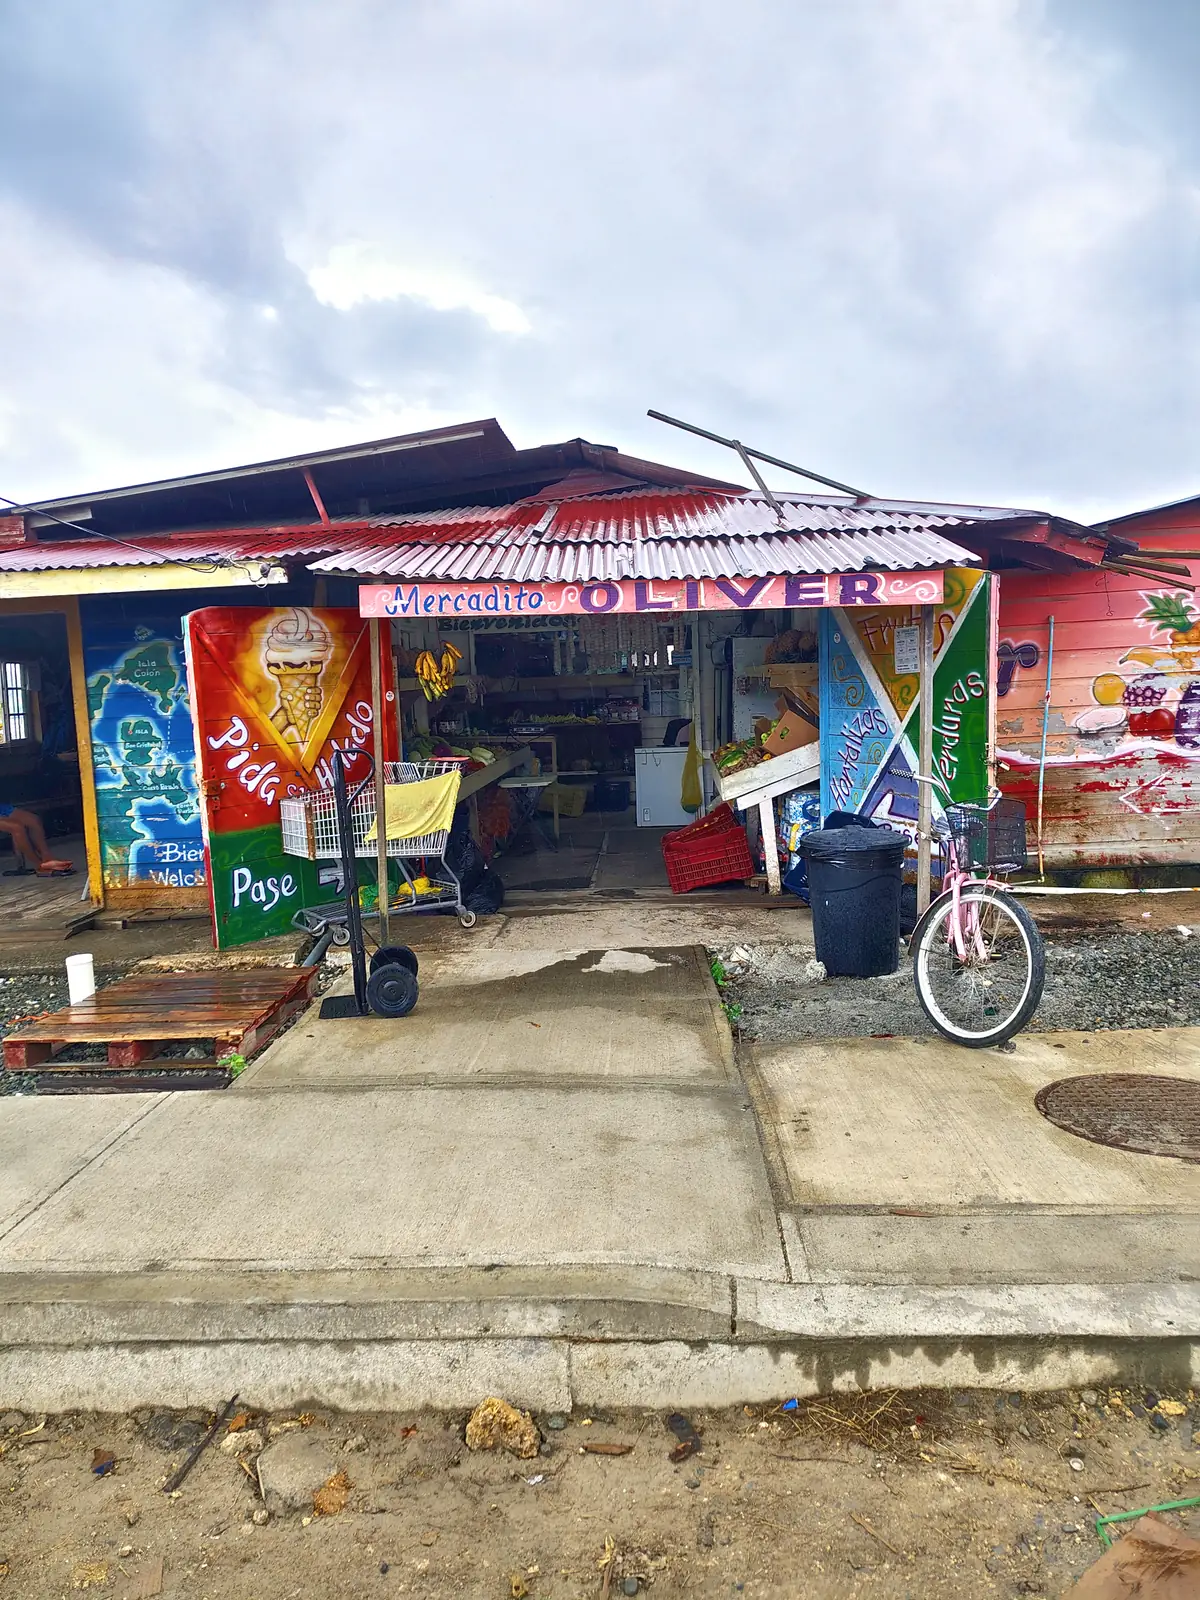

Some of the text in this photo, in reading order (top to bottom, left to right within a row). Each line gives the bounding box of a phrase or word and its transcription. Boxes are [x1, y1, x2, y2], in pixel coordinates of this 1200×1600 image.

[385, 573, 886, 615] Mercadito OLIVER
[208, 715, 281, 806] Pida
[315, 701, 374, 789] Hlado
[232, 867, 298, 912] Pase
